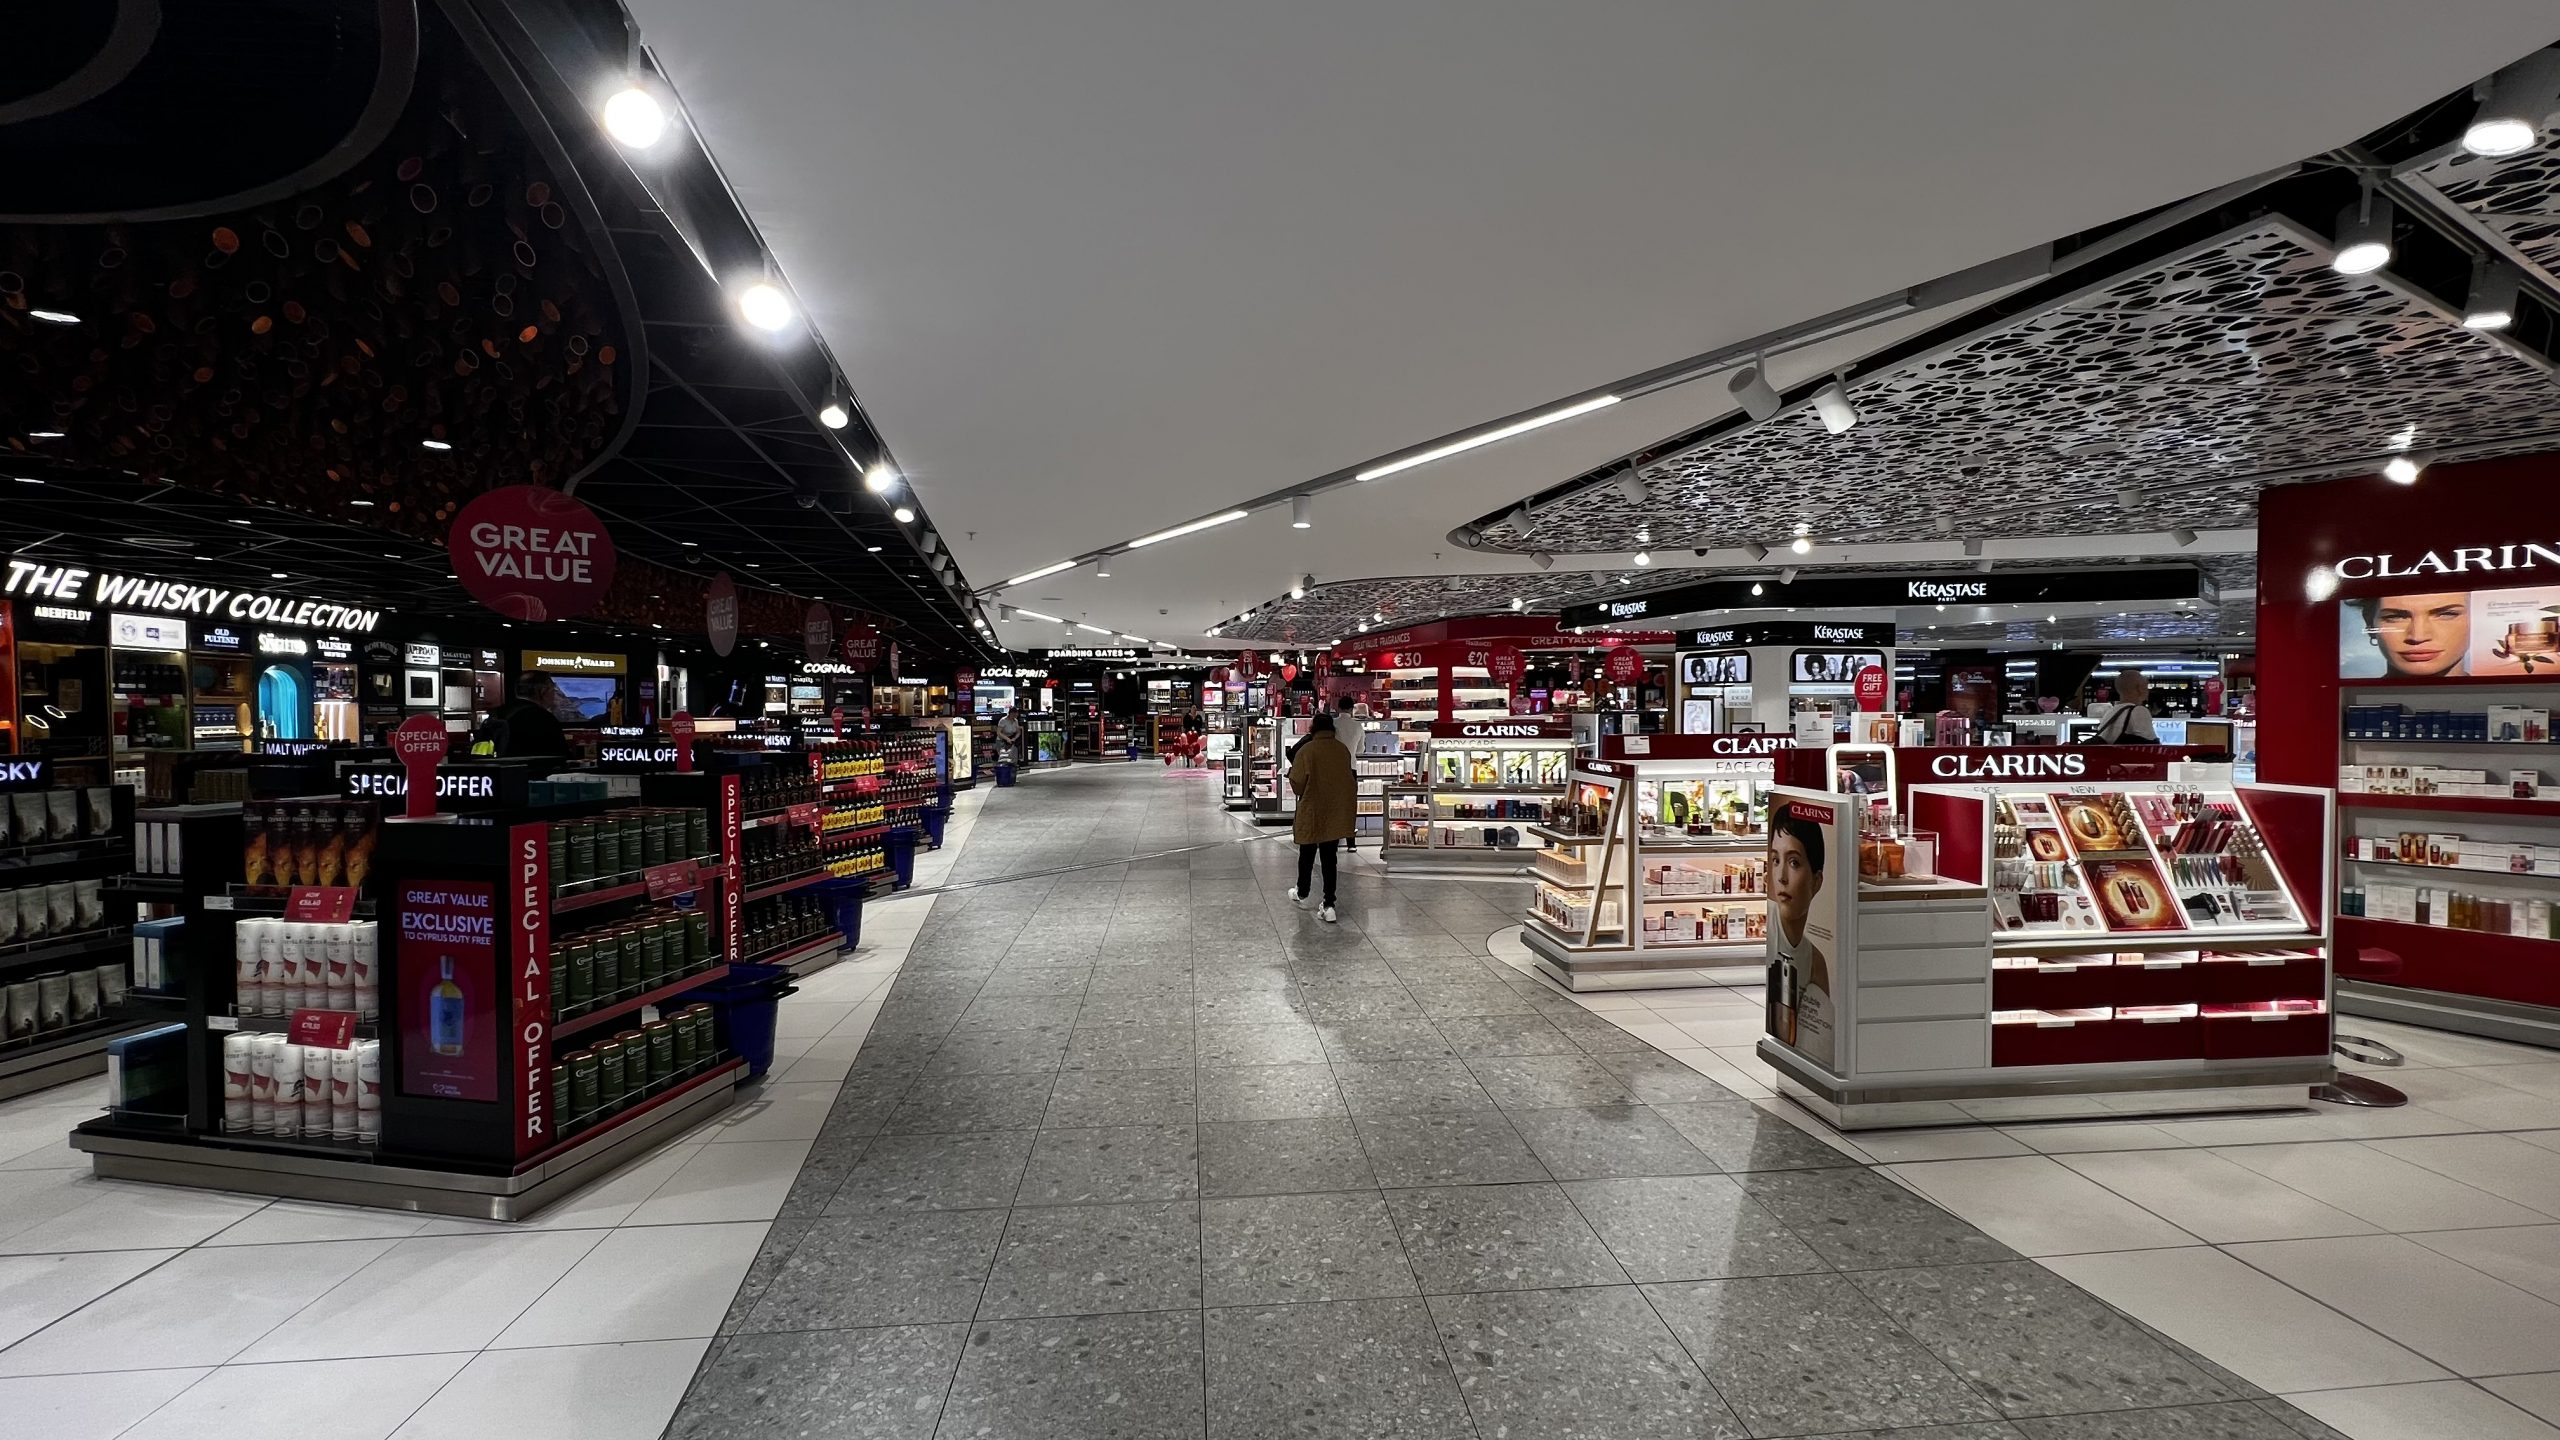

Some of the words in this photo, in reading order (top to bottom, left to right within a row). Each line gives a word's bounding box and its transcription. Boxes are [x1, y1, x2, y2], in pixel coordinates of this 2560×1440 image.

[470, 522, 597, 556] GREAT
[474, 550, 593, 584] VALUE
[4, 560, 90, 599] THE
[95, 573, 230, 615] WHISKY
[229, 593, 381, 633] COLLECTION
[1908, 581, 1987, 598] KÉRASTASE
[710, 596, 734, 614] GREAT
[1611, 601, 1648, 617] KÉRASTASE
[34, 606, 92, 622] ABERFELDY
[710, 614, 734, 632] VALUE
[807, 620, 829, 633] GREAT
[214, 628, 230, 636] OLD
[1380, 632, 1411, 646] FRAGRANCES
[1697, 630, 1734, 644] KÉRASTASE
[1814, 625, 1864, 640] KÉRASTASE
[204, 635, 240, 645] PULTENEY
[316, 640, 352, 652] TALISKER
[847, 638, 877, 649] GREAT
[1531, 636, 1565, 646] GREAT
[847, 649, 877, 658] VALUE
[1047, 649, 1094, 658] BOARDING
[1095, 649, 1124, 658] GATES
[1393, 652, 1422, 667] €30
[582, 657, 616, 668] WALKER
[803, 663, 856, 674] COGNAC
[981, 668, 1013, 678] LOCAL
[1015, 668, 1049, 678] SPIRITS
[1862, 673, 1883, 683] FREE
[897, 677, 929, 685] Hennessy
[1863, 682, 1882, 692] GIFT
[674, 727, 692, 735] OFFER
[1462, 725, 1540, 737] CLARINS
[2154, 721, 2181, 729] ICHY
[399, 731, 446, 741] SPECIAL
[266, 743, 290, 756] MALT
[404, 742, 441, 753] OFFER
[601, 748, 652, 762] SPECIAL
[654, 748, 695, 763] OFFR
[1716, 760, 1752, 773] FACE
[1932, 753, 2086, 777] CLARINS
[349, 774, 409, 796] SPECIA
[2071, 785, 2096, 794] NEW
[2156, 784, 2199, 793] COLOUR
[1791, 804, 1831, 820] CLARINS
[727, 784, 738, 881] SPECIAL
[406, 890, 448, 905] GREAT
[450, 893, 489, 908] VALUE
[402, 911, 494, 935] EXCLUSIVE
[522, 839, 542, 1002] SPECIAL
[728, 892, 739, 961] OFFER
[404, 931, 415, 940] TO
[416, 932, 447, 942] CYPRUS
[449, 934, 471, 944] DUTY
[471, 936, 492, 946] FREE
[523, 1022, 544, 1139] OFFER
